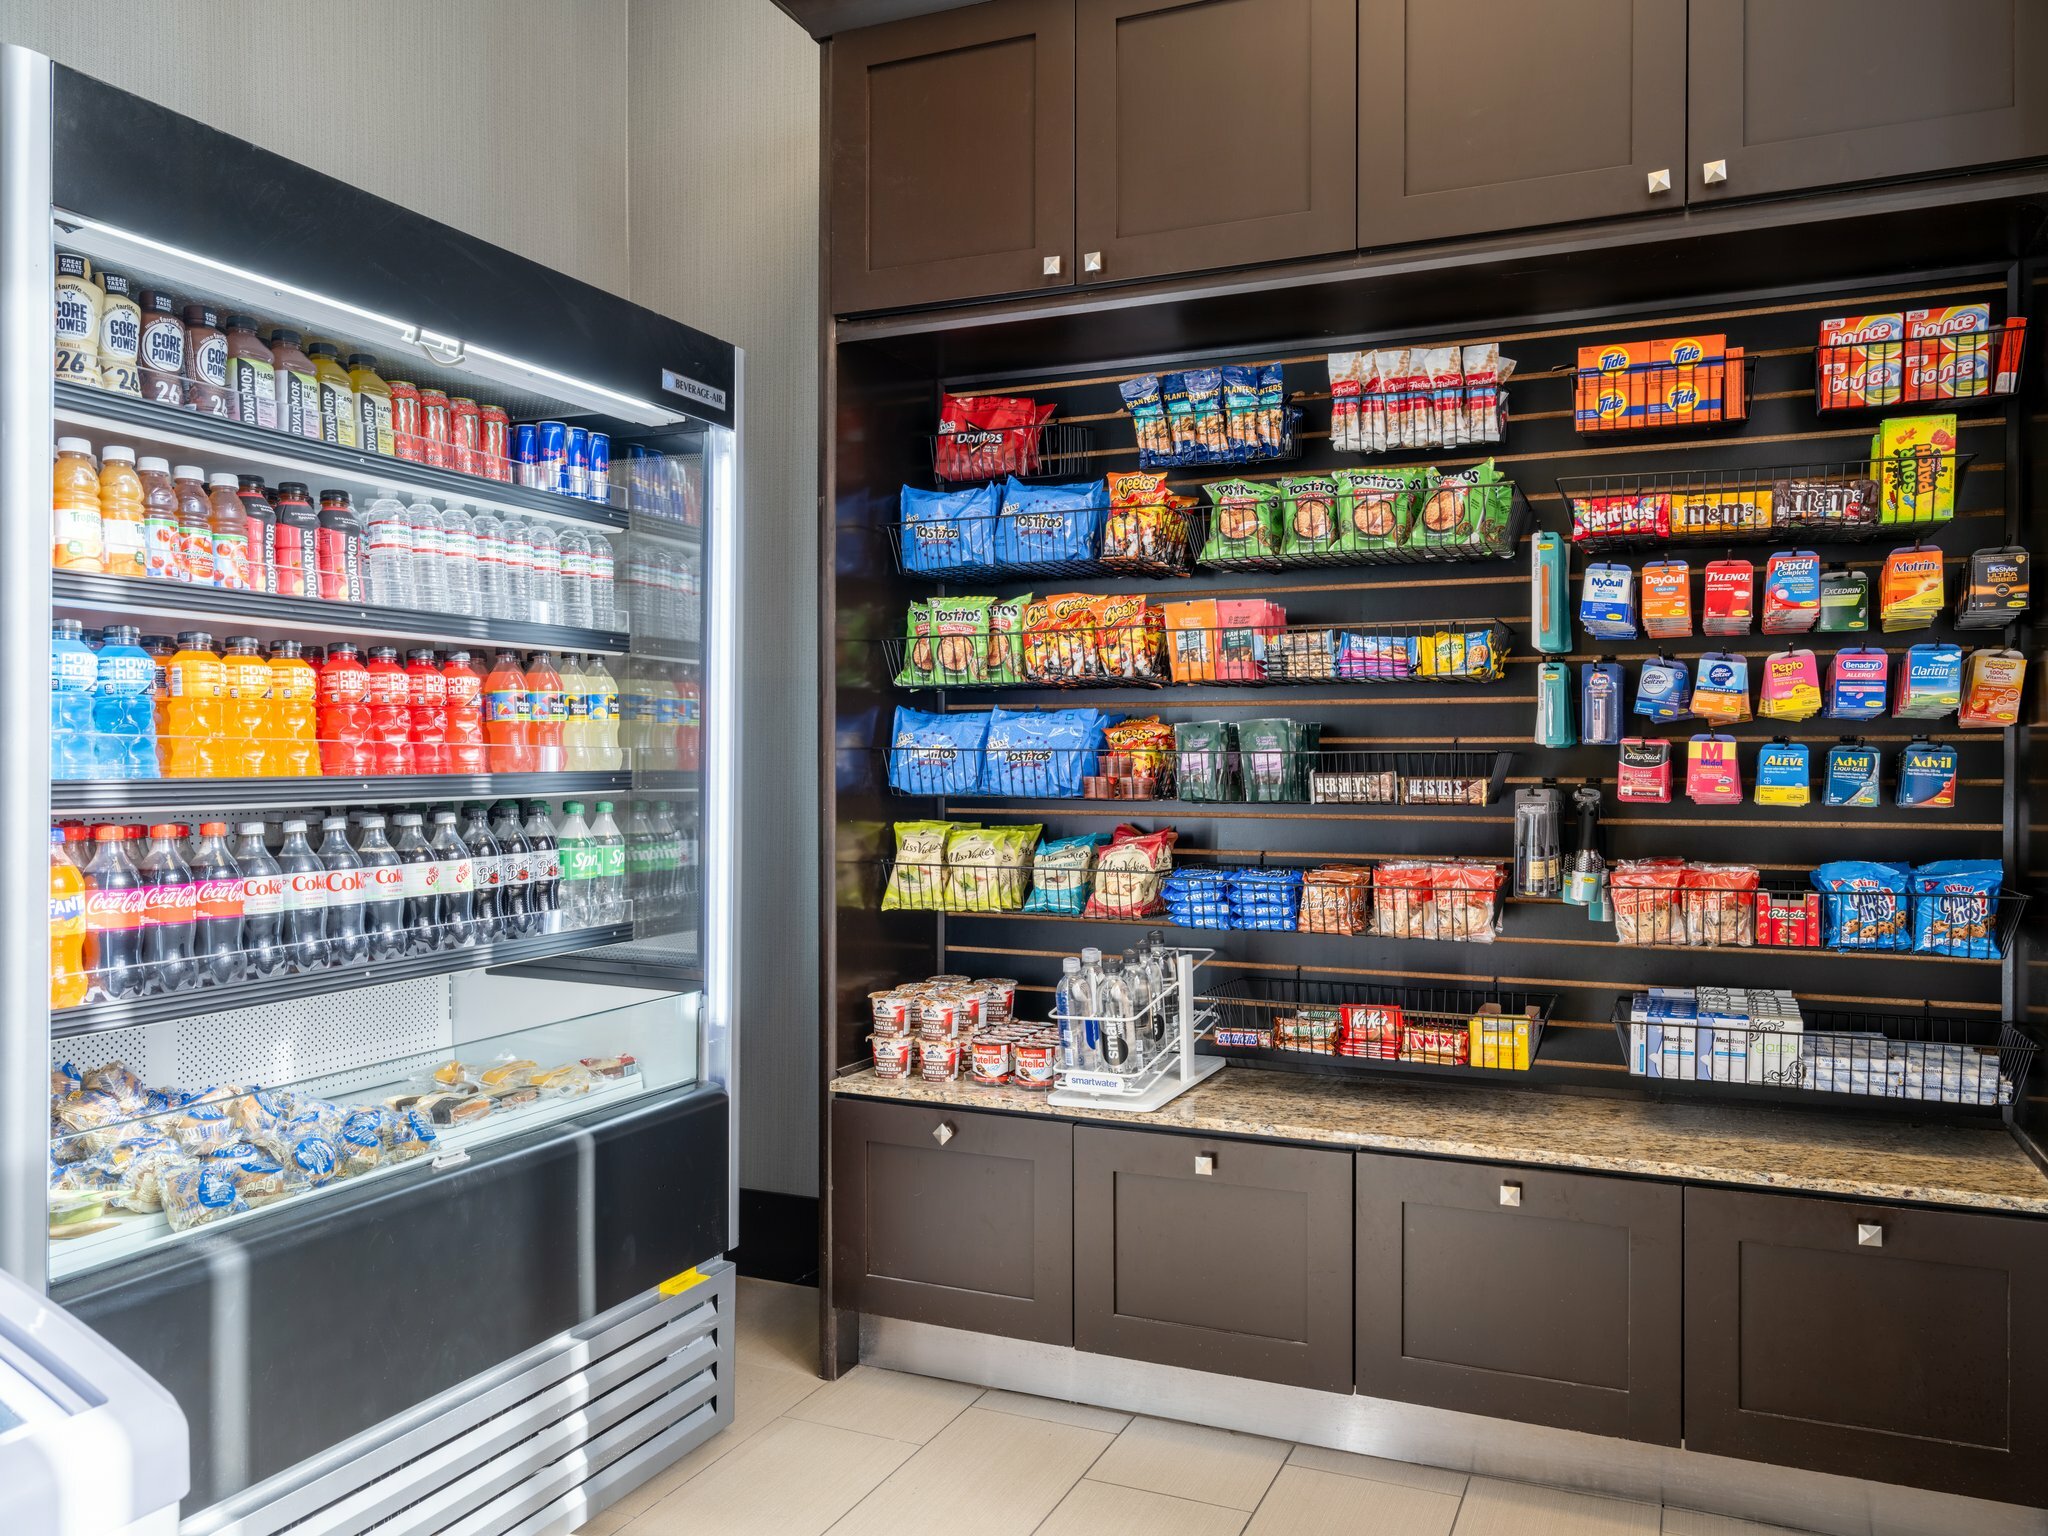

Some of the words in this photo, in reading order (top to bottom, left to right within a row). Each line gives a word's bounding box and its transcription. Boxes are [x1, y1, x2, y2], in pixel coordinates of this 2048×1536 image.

[110, 320, 138, 339] CORE
[1912, 313, 1977, 338] bounce
[1829, 323, 1892, 347] bounce
[111, 335, 136, 352] POWER
[152, 332, 181, 353] CORE
[152, 349, 180, 368] POWER
[1674, 346, 1700, 364] Tide
[1600, 354, 1626, 371] Tide
[1912, 360, 1975, 385] bounce
[1409, 381, 1432, 390] Fisher
[1829, 368, 1891, 393] bounce
[675, 378, 723, 403] BEVERAGE-AIR
[1332, 384, 1358, 396] Fisher
[1126, 393, 1159, 409] PLANTERS
[1600, 396, 1624, 414] Tide
[1670, 390, 1697, 408] Tide
[956, 432, 1003, 444] Doritos
[543, 448, 560, 457] Red
[1900, 448, 1916, 494] SOUR
[1916, 444, 1934, 494] PATCH
[1116, 476, 1158, 499] Cheetos
[1584, 504, 1656, 528] Skittles
[303, 530, 316, 597] BODYARMOR
[348, 536, 360, 601] BODYARMOR
[1775, 559, 1813, 571] Pepcid
[1894, 560, 1936, 572] Motrin
[1987, 566, 2018, 574] LifeStyles
[1592, 578, 1623, 588] NyQuil
[1645, 575, 1684, 587] DayQuil
[1707, 572, 1750, 582] TYLENOL
[1771, 661, 1803, 673] Pepto
[1845, 662, 1879, 670] Benadryl
[1911, 666, 1949, 676] Claritin
[115, 669, 144, 681] ADE
[240, 675, 265, 685] ADE
[340, 680, 363, 690] ADE
[448, 686, 469, 694] ADE
[1701, 743, 1723, 759] M
[1765, 755, 1804, 767] ALEVE
[1834, 756, 1869, 767] Advil
[1908, 756, 1952, 769] Advil
[1316, 778, 1370, 793] HERSHEY'S
[1409, 779, 1463, 796] HERSHEY'S
[968, 848, 996, 860] Vickie's
[243, 879, 282, 897] Coke
[1854, 878, 1879, 888] Mini
[1945, 884, 1974, 893] Mini
[1621, 902, 1655, 915] COOKIE
[1770, 909, 1806, 919] Ricola
[1219, 1033, 1258, 1045] SNICKERS
[1479, 1035, 1518, 1046] HALLS
[1664, 1035, 1693, 1044] Maxithins
[1716, 1036, 1745, 1045] Maxithins
[1755, 1042, 1796, 1054] gards
[974, 1056, 1000, 1064] nutella
[1018, 1060, 1044, 1068] nutella
[1071, 1075, 1118, 1088] smartwater
